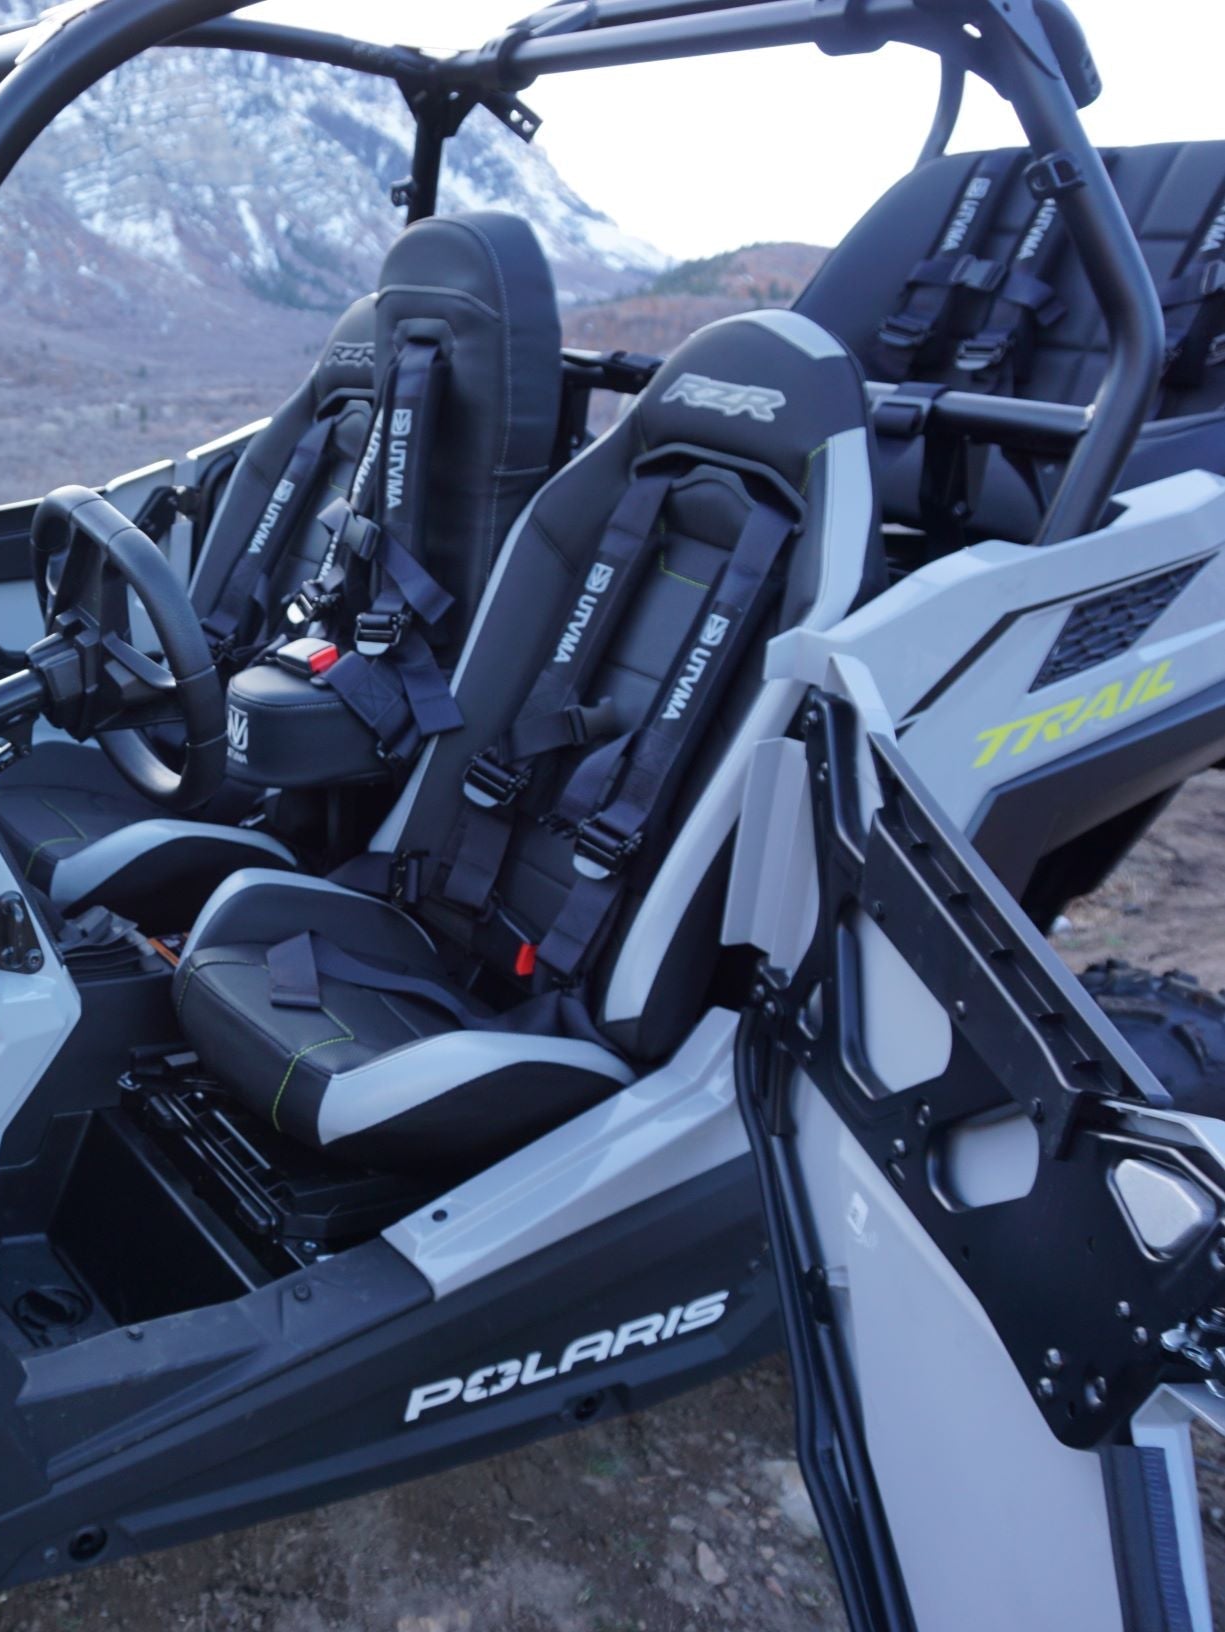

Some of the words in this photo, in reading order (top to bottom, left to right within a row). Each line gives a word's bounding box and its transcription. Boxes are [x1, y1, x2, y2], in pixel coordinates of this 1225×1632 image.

[941, 200, 980, 252] UTVMA
[660, 372, 787, 423] RZR
[387, 440, 408, 509] UTVMA
[248, 502, 283, 555] UTVMA
[553, 594, 598, 663] UTVMA
[662, 647, 712, 720] UTVMA
[973, 659, 1176, 769] TRAIL
[403, 1289, 730, 1423] POLARIS
